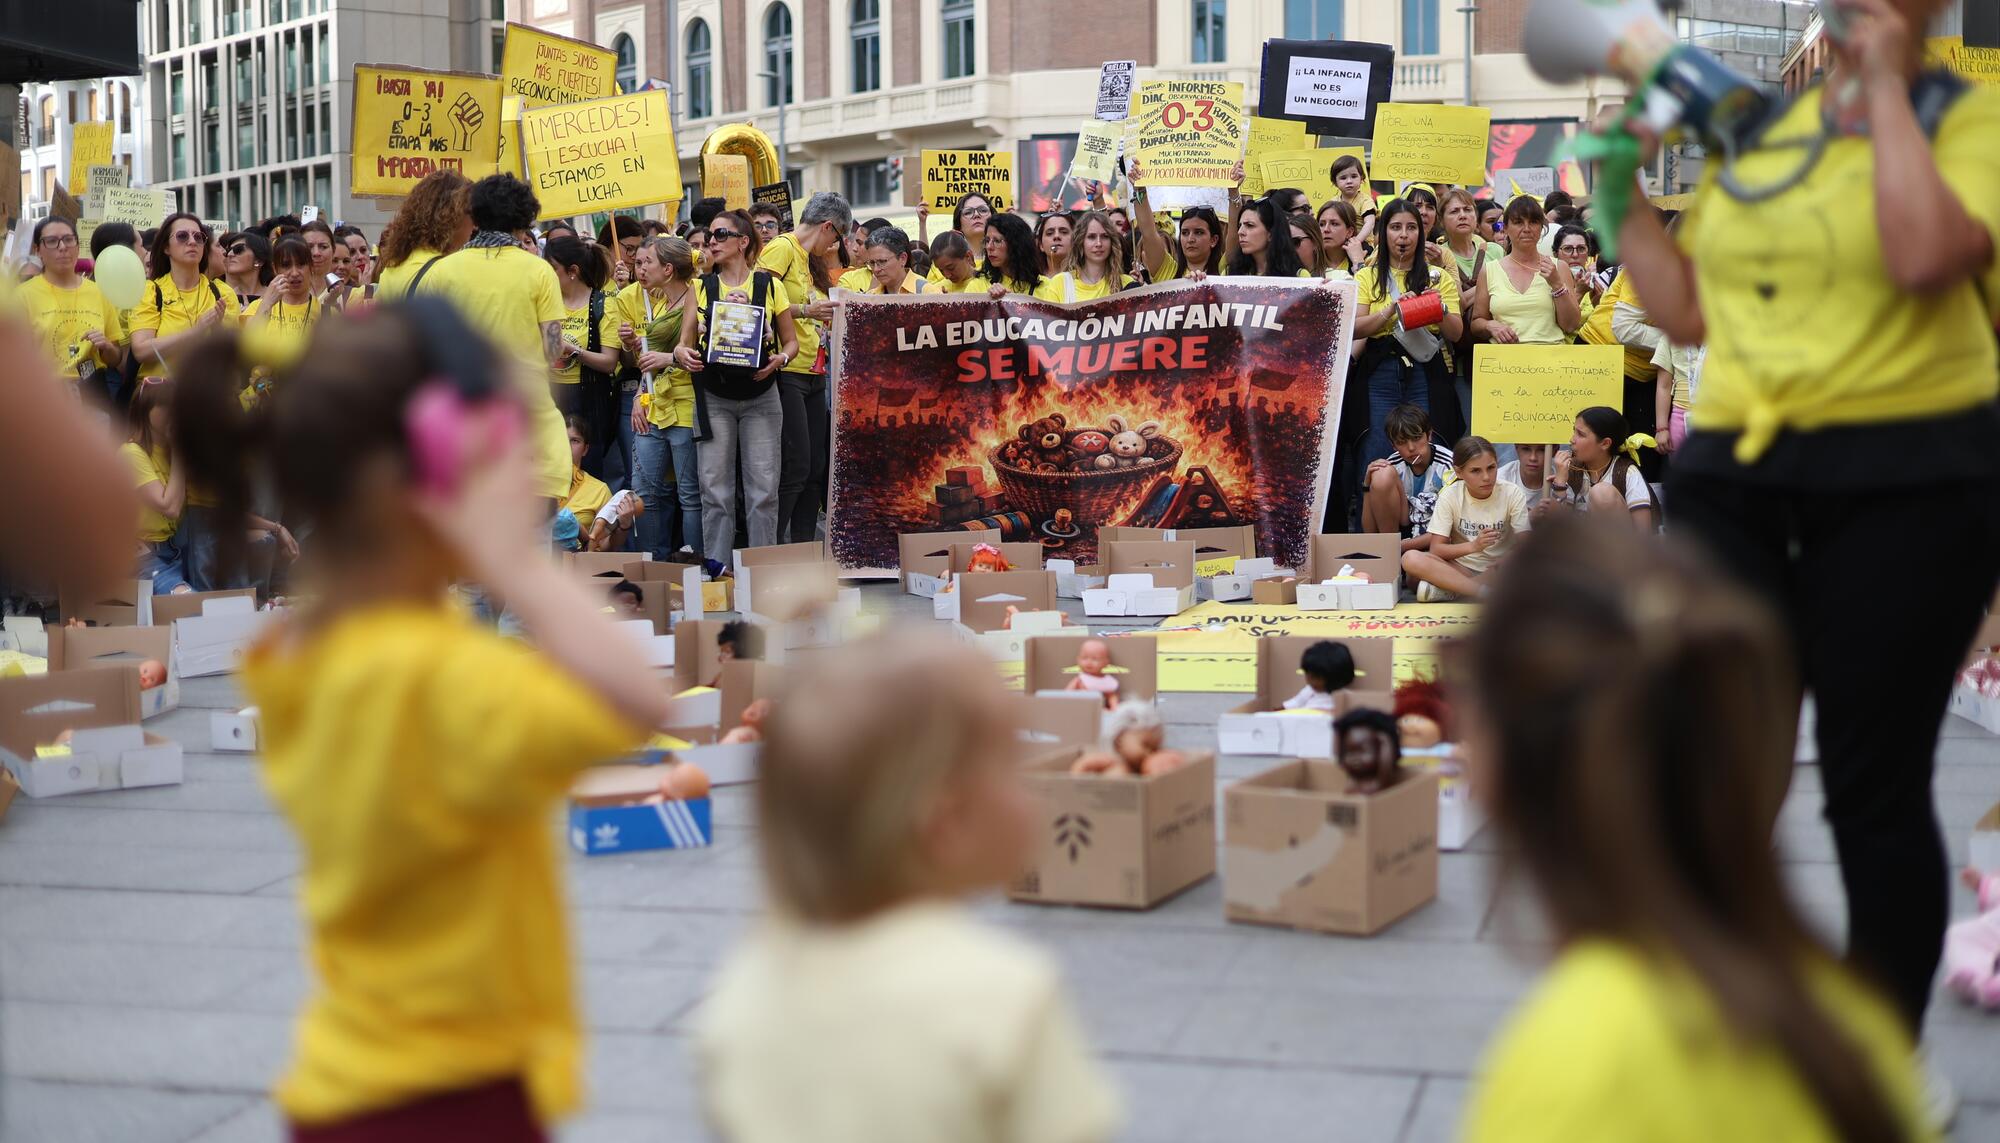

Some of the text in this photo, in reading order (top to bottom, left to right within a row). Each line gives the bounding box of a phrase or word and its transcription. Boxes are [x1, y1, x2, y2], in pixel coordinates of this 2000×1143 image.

[571, 50, 599, 71] SOMOS
[1105, 63, 1129, 72] HUELGA
[1303, 68, 1316, 76] LA
[1318, 69, 1363, 80] INFANCIA
[534, 63, 602, 95] MÁS FUERTES!
[1168, 81, 1226, 95] INFORMES
[1313, 83, 1342, 92] NO ES
[1294, 96, 1359, 108] UN NEGOCIO!!
[403, 101, 431, 122] 0-3
[1161, 100, 1215, 132] 0-3
[1213, 106, 1241, 139] RATIOS
[1381, 110, 1434, 129] POR UNA
[392, 120, 432, 138] ES LA
[388, 135, 448, 152] ETAPA MÁS
[938, 153, 995, 166] NO HAY
[1183, 149, 1211, 157] TRABAJO
[1376, 151, 1386, 159] LO
[1175, 157, 1234, 166] RESPONSABILIDAD
[92, 168, 123, 177] NORMATIVA
[539, 155, 645, 190] ESTAMOS EN
[928, 165, 1010, 182] ALTERNATIVA
[1154, 168, 1174, 179] POCO
[1177, 167, 1232, 180] RECONOCIMIENT
[94, 177, 121, 186] ESTATAL
[110, 190, 121, 198] NO
[577, 181, 623, 203] LUCHA
[896, 302, 1286, 352] LA EDUCACIÓN INFANTIL
[956, 335, 1209, 384] SE MUERE
[1562, 366, 1611, 377] TITULADAS
[1490, 389, 1505, 397] en
[1513, 385, 1531, 397] la
[1503, 411, 1571, 424] EQUIVOCADA
